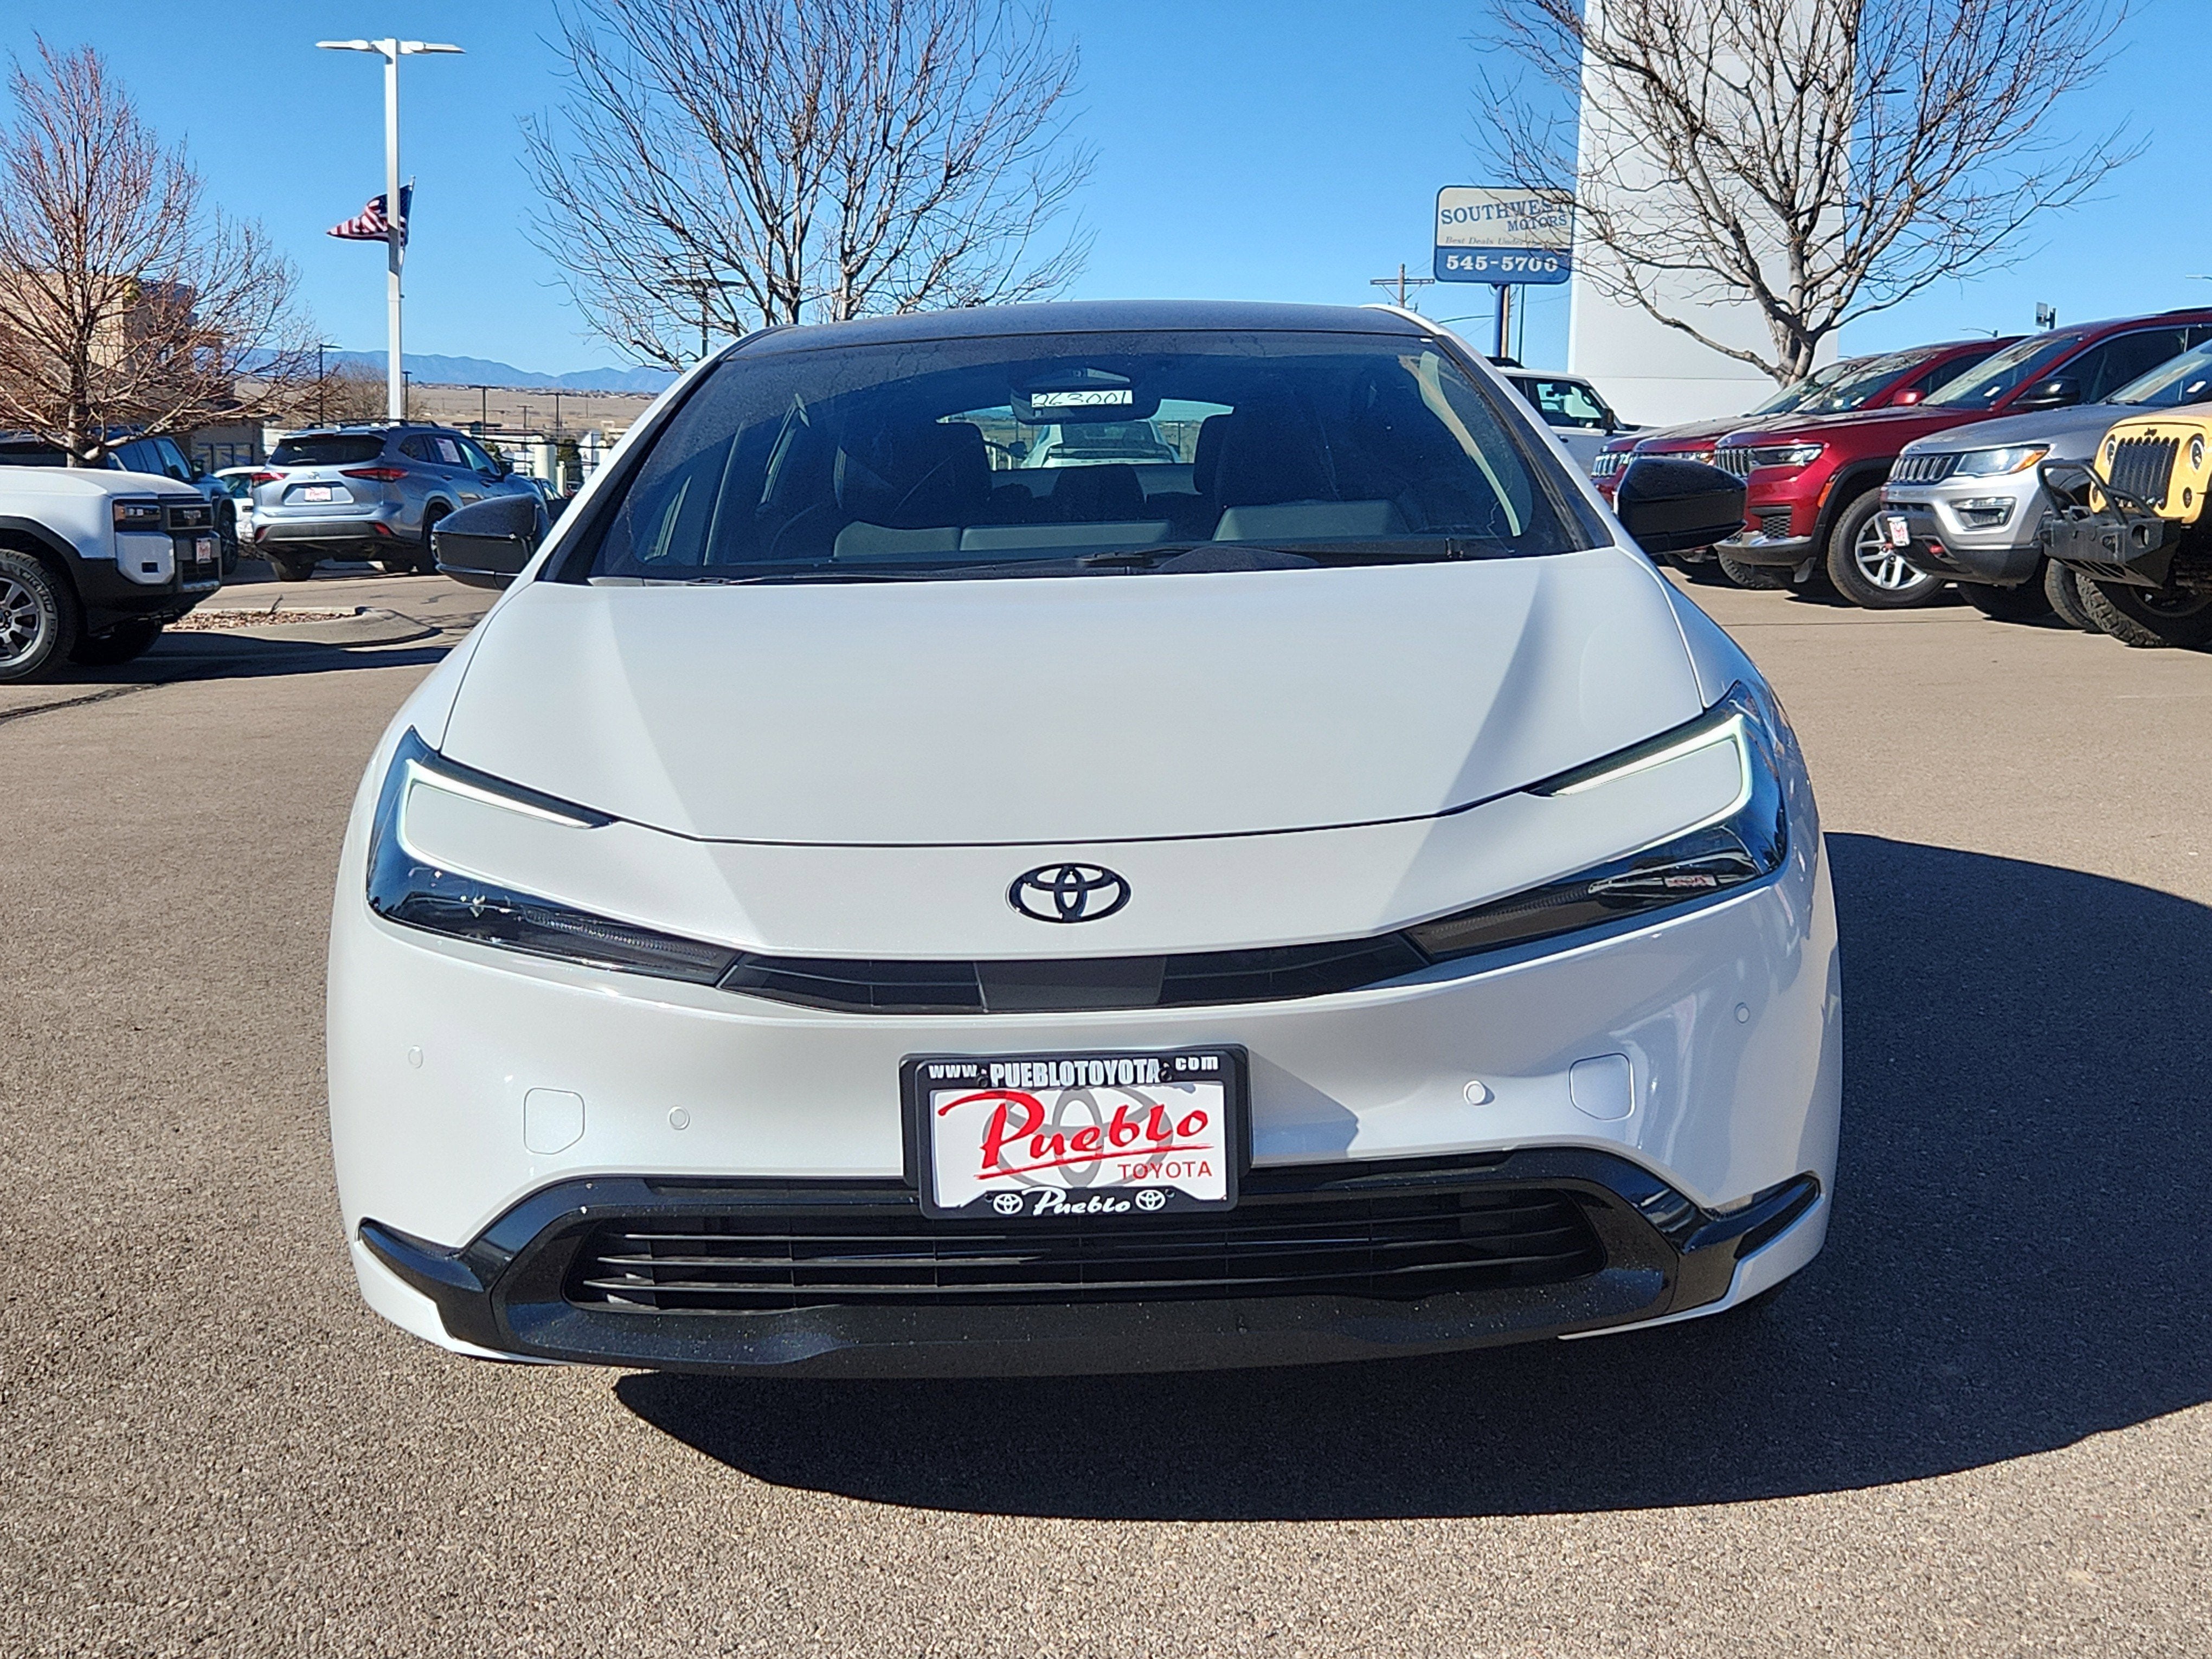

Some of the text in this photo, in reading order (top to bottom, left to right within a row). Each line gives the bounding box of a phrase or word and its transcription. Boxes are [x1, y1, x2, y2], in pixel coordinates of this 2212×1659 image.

[1507, 214, 1567, 232] MOTORS
[1445, 236, 1464, 245] Best
[1469, 236, 1494, 245] Deals
[1446, 255, 1558, 272] 545-5700
[937, 1089, 1209, 1169] Pueblo
[1117, 1161, 1213, 1180] TOYOTA
[1021, 1186, 1133, 1217] Pueblo
